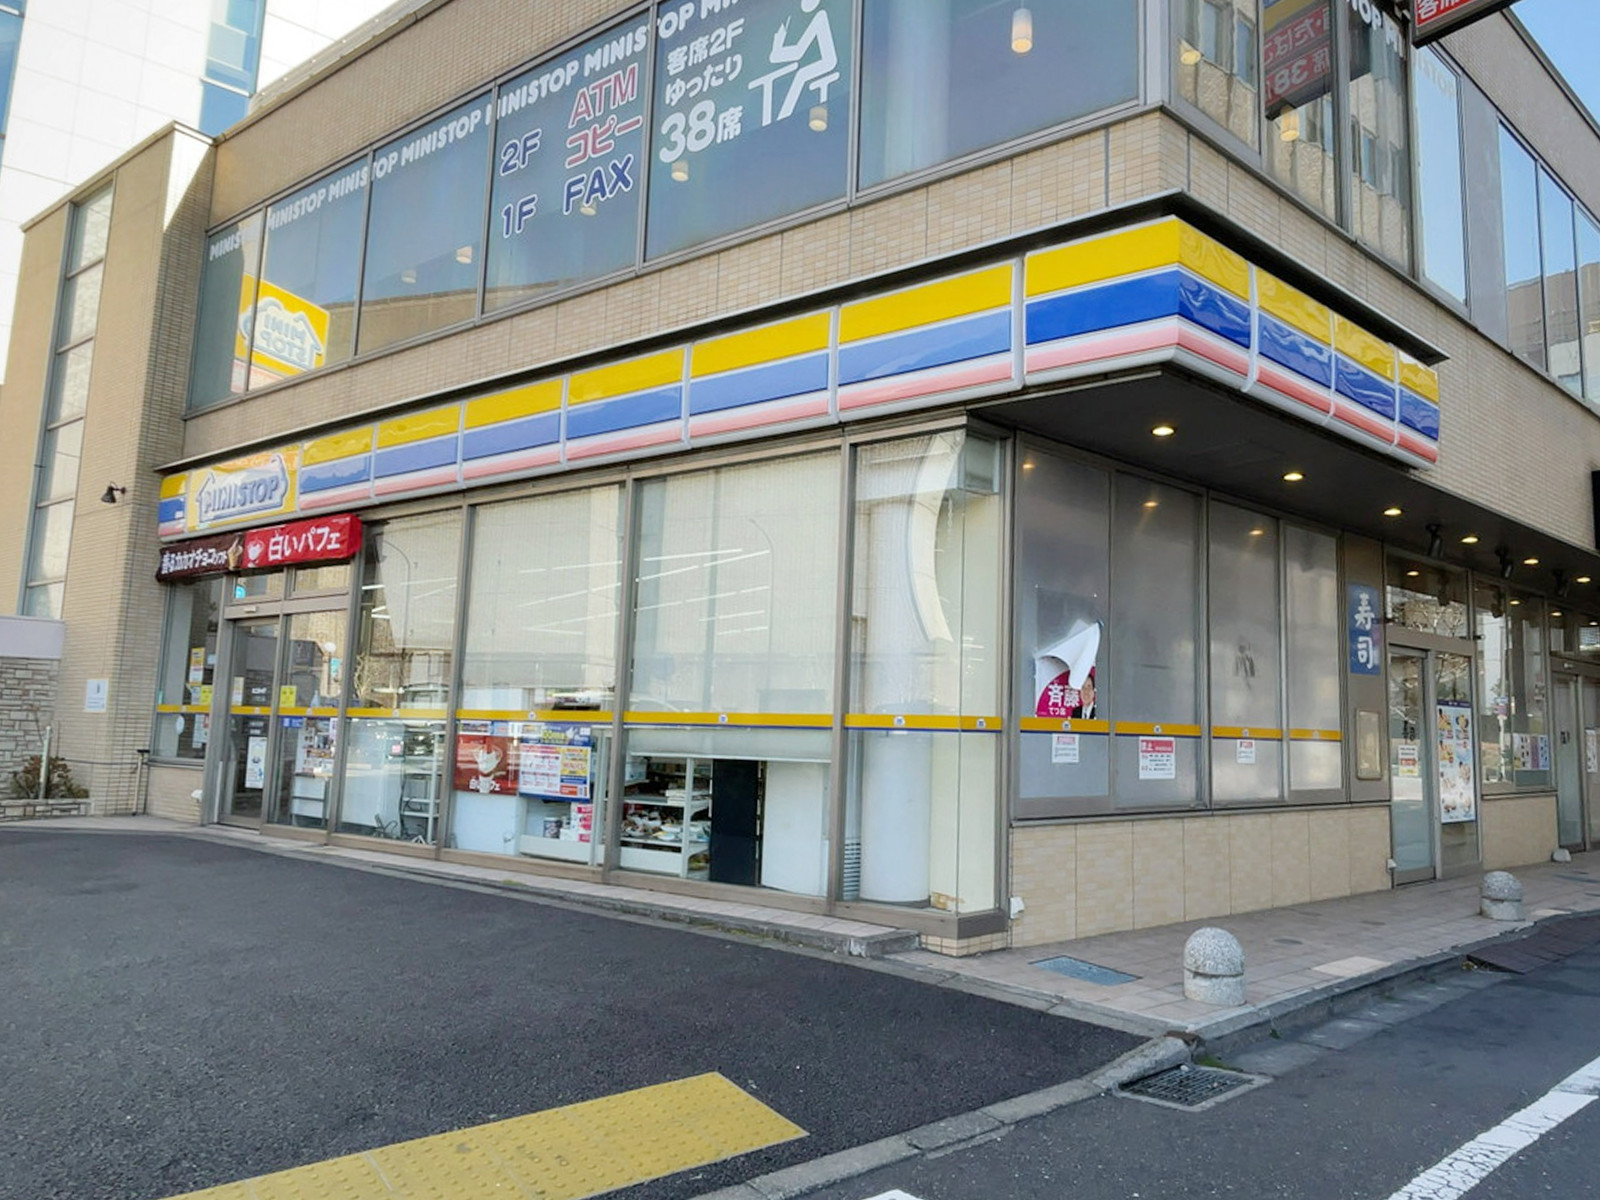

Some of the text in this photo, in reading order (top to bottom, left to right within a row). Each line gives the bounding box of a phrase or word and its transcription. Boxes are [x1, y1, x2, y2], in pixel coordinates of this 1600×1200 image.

[666, 17, 745, 76] 客席2F
[567, 62, 639, 129] ATM
[665, 54, 743, 107] ゆったり
[500, 128, 543, 176] 2F
[565, 115, 643, 169] コピー
[658, 99, 744, 164] 38席
[266, 186, 327, 233] MINISTOP
[401, 108, 481, 168] MINISTOP
[562, 153, 634, 215] FAX
[501, 195, 538, 238] 1F
[203, 475, 280, 514] MINISTOP
[267, 526, 341, 562] 白いパフェ
[1354, 592, 1375, 669] 寿司
